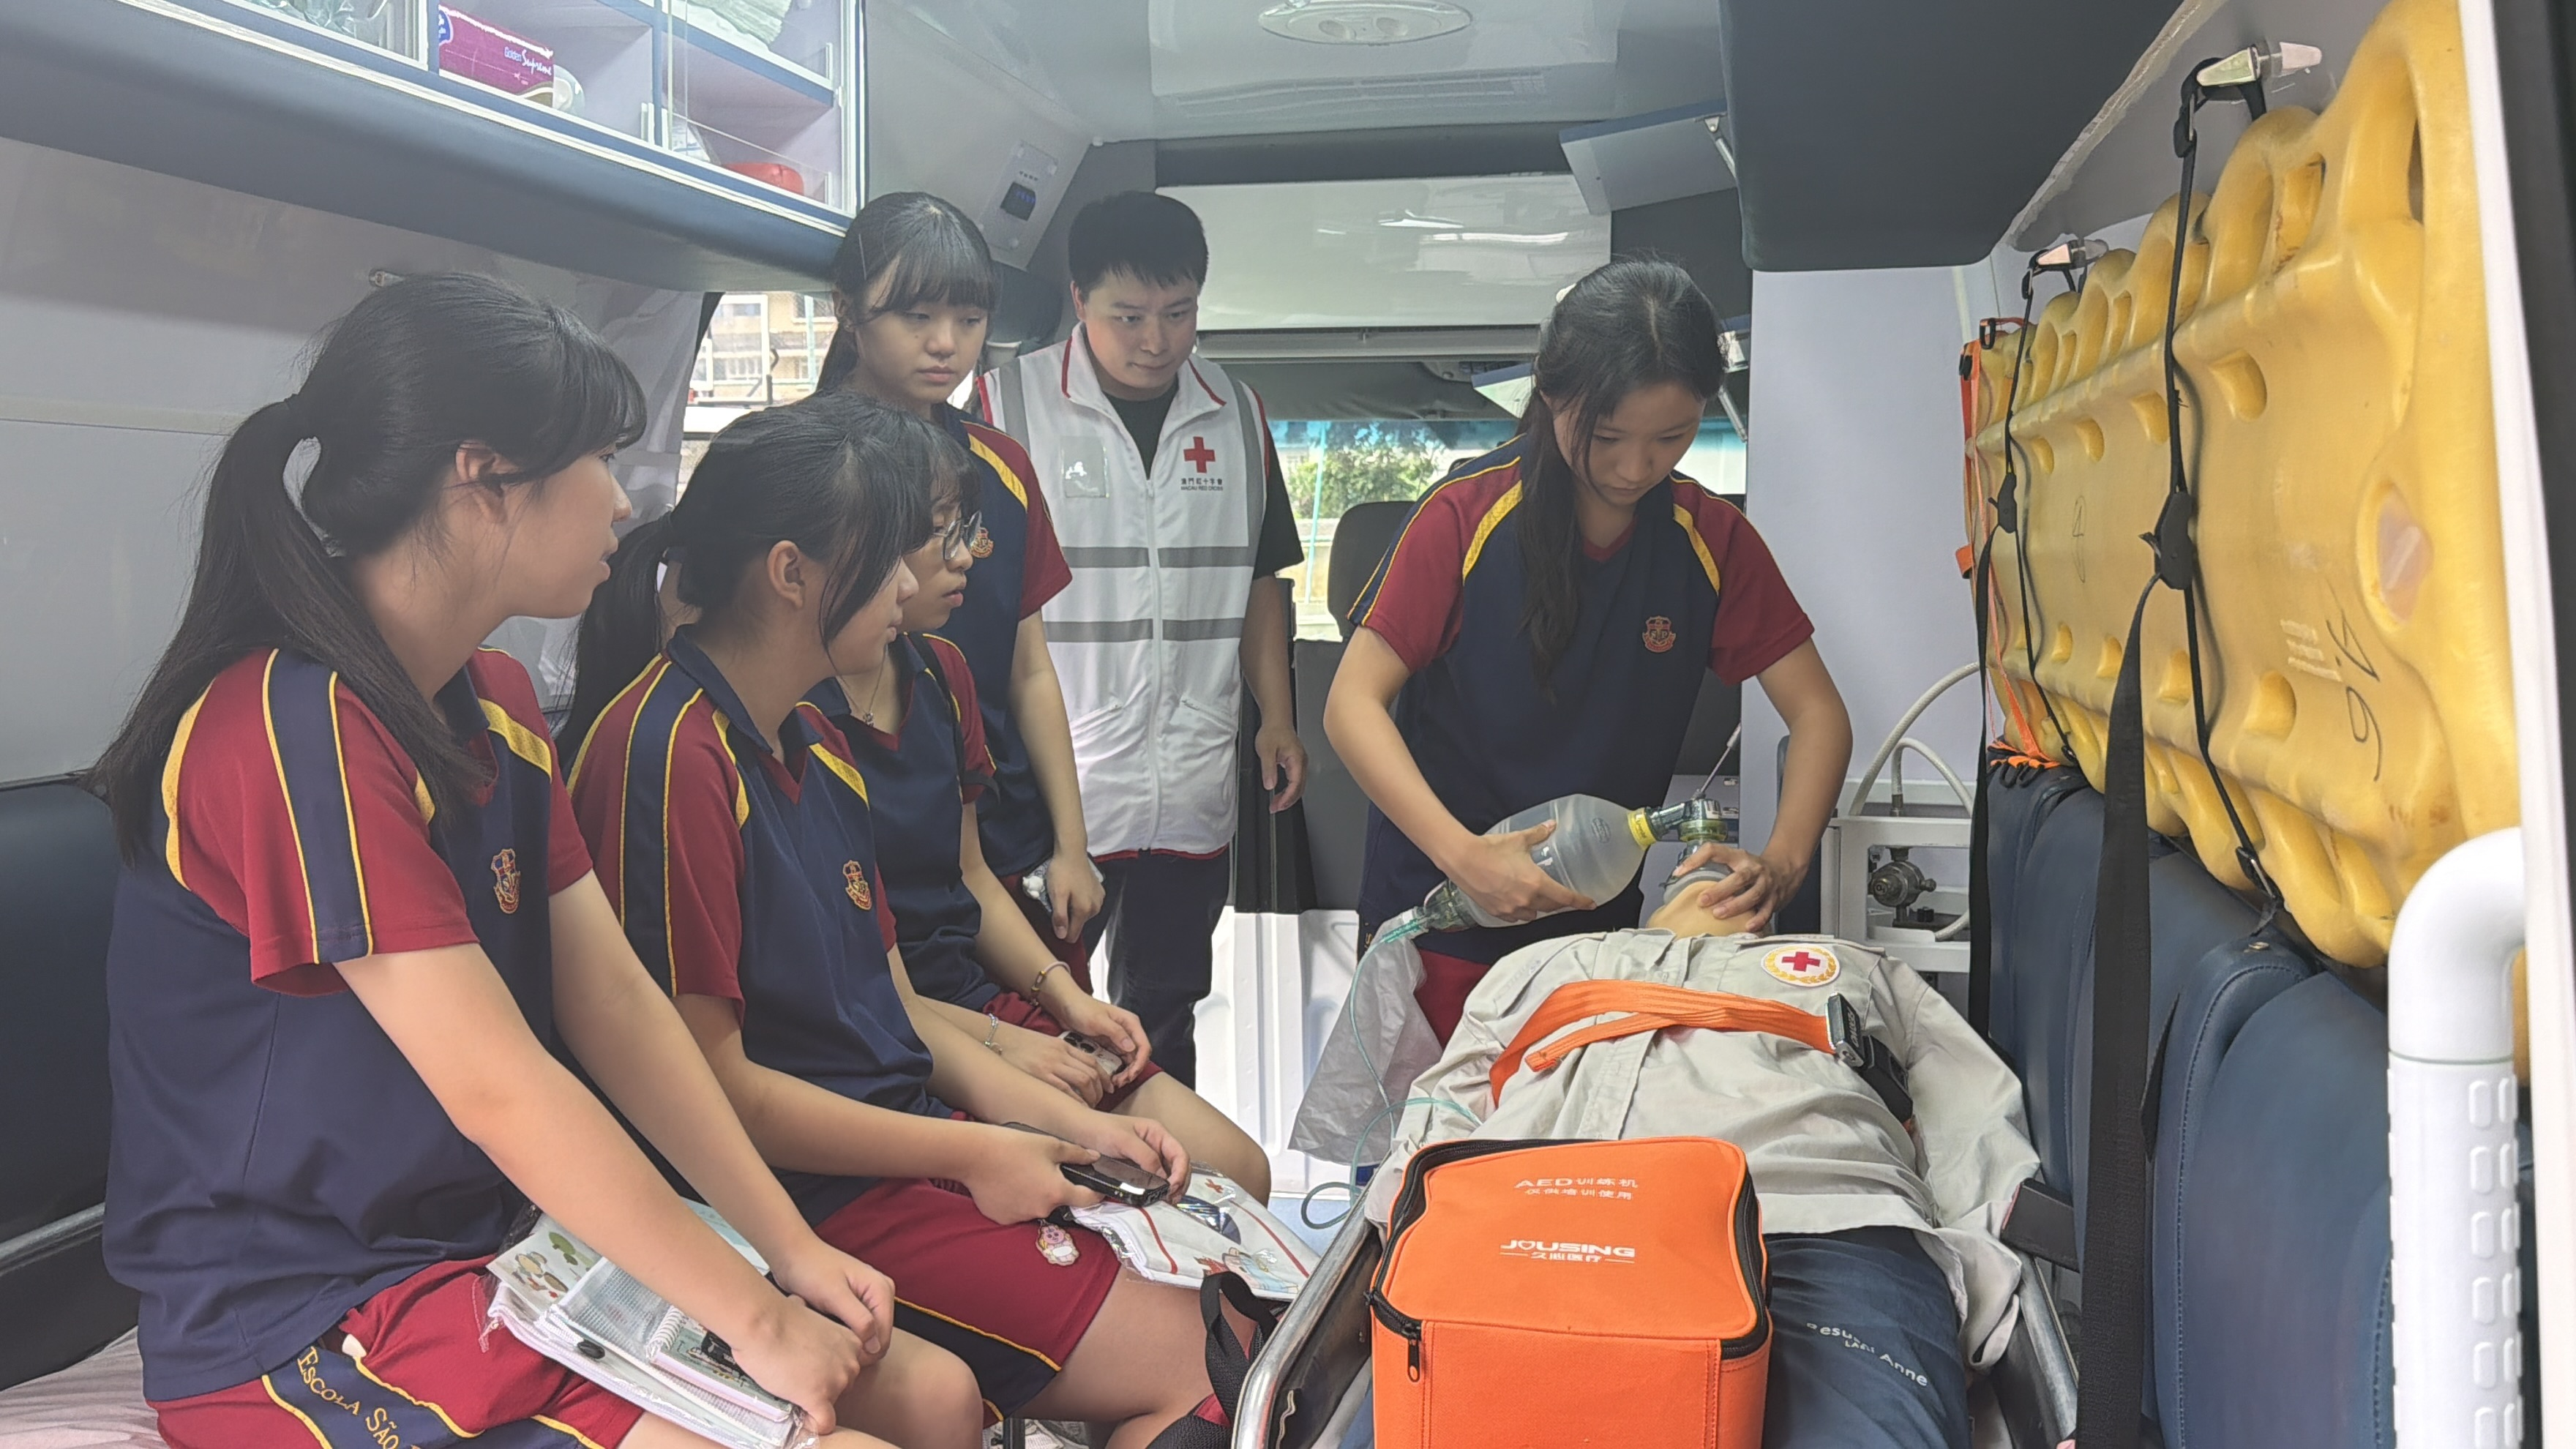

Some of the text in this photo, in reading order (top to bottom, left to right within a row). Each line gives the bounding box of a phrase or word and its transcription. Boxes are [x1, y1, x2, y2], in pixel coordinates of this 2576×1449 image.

[504, 47, 552, 75] Golden Supreme
[1500, 1240, 1636, 1258] JOUSING
[1530, 1251, 1603, 1263] 久心医疗
[1879, 1353, 1928, 1387] Anne
[297, 1346, 399, 1449] ESCOLA SÃO
